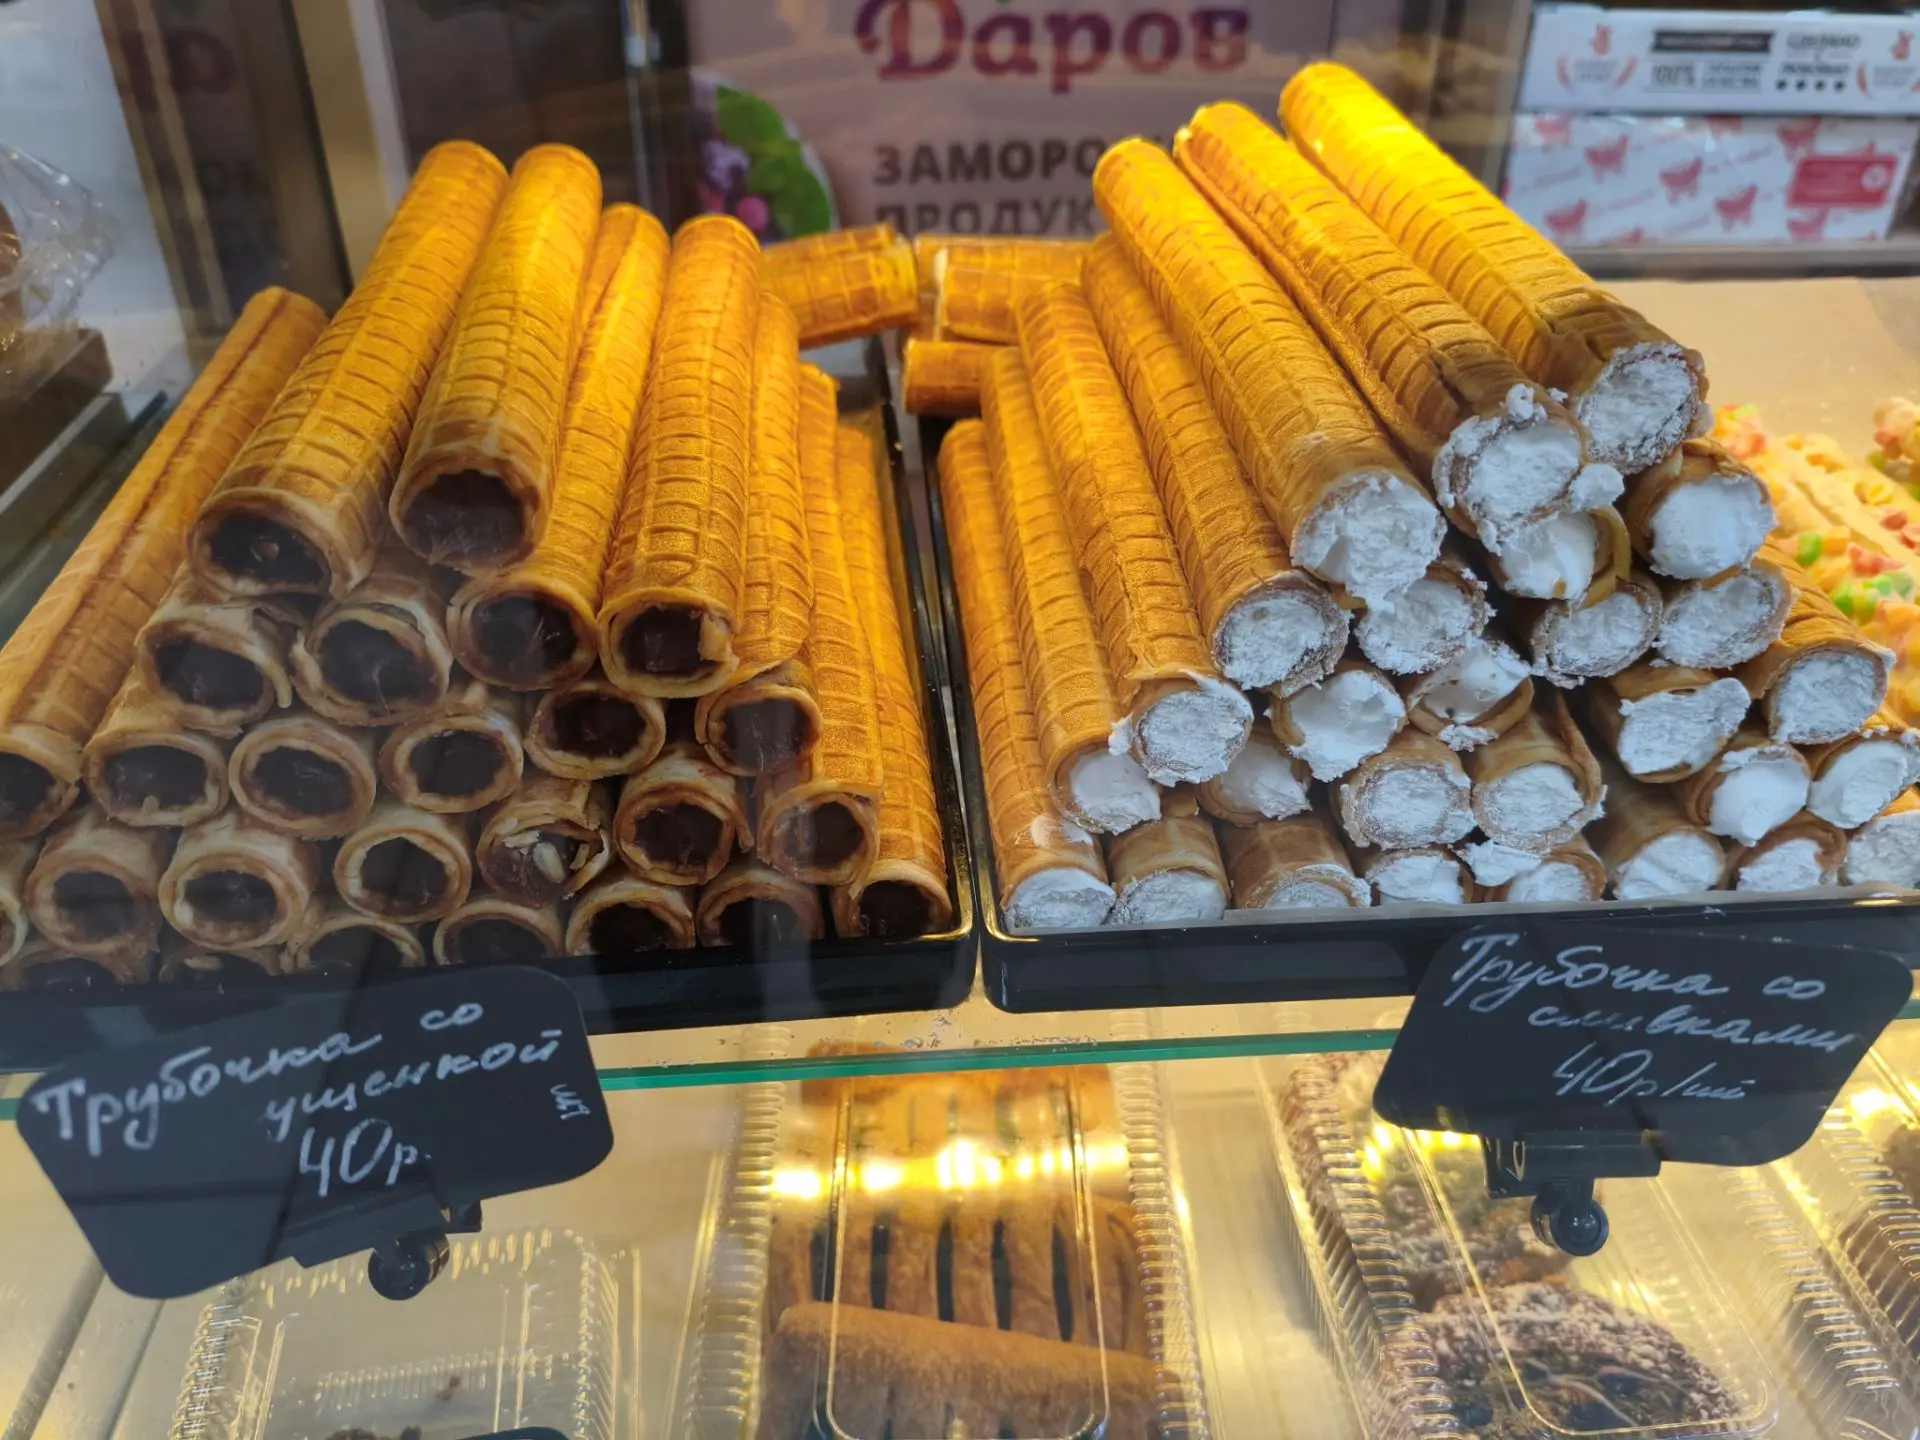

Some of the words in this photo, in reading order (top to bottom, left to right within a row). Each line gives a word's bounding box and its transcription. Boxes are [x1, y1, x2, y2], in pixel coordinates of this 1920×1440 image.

[872, 136, 1175, 186] ЗАМОРО
[1443, 933, 1728, 1013] Трубочка
[1762, 974, 1826, 999] со
[35, 1031, 384, 1157] Трубочка
[419, 1002, 484, 1031] со
